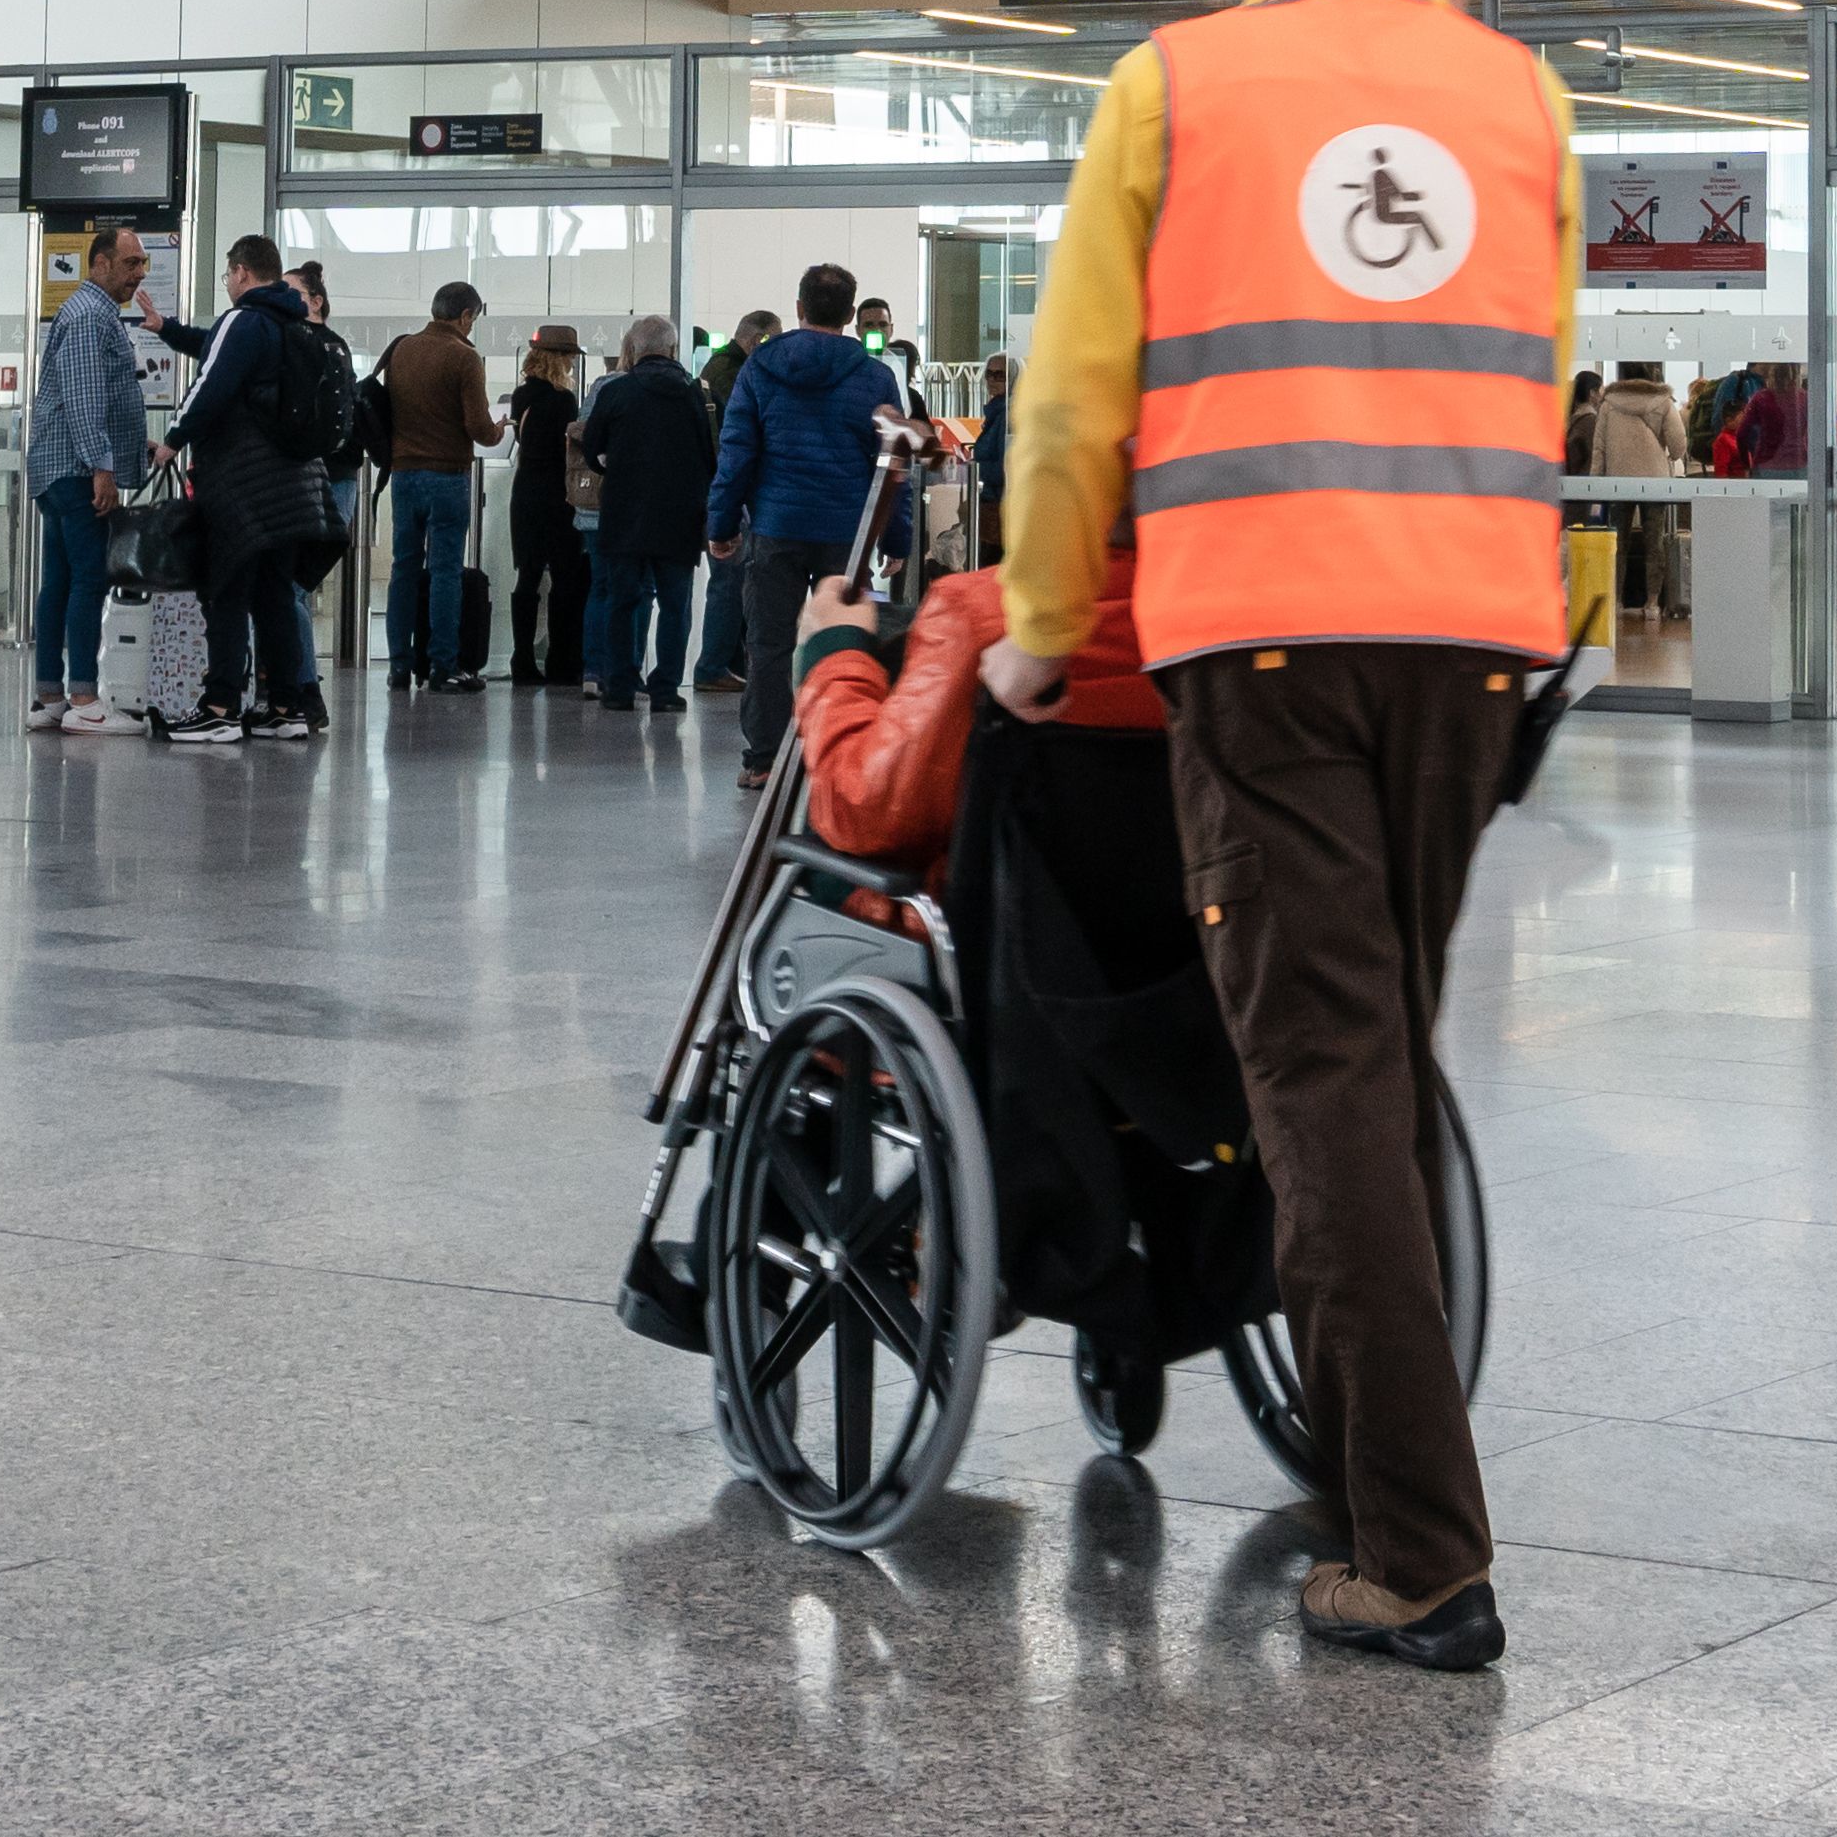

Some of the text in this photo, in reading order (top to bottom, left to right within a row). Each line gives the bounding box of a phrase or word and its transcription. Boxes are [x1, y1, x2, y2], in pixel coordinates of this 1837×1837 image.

[78, 116, 125, 130] Phone 091
[94, 135, 108, 144] and
[61, 149, 96, 158] download
[80, 164, 121, 174] application
